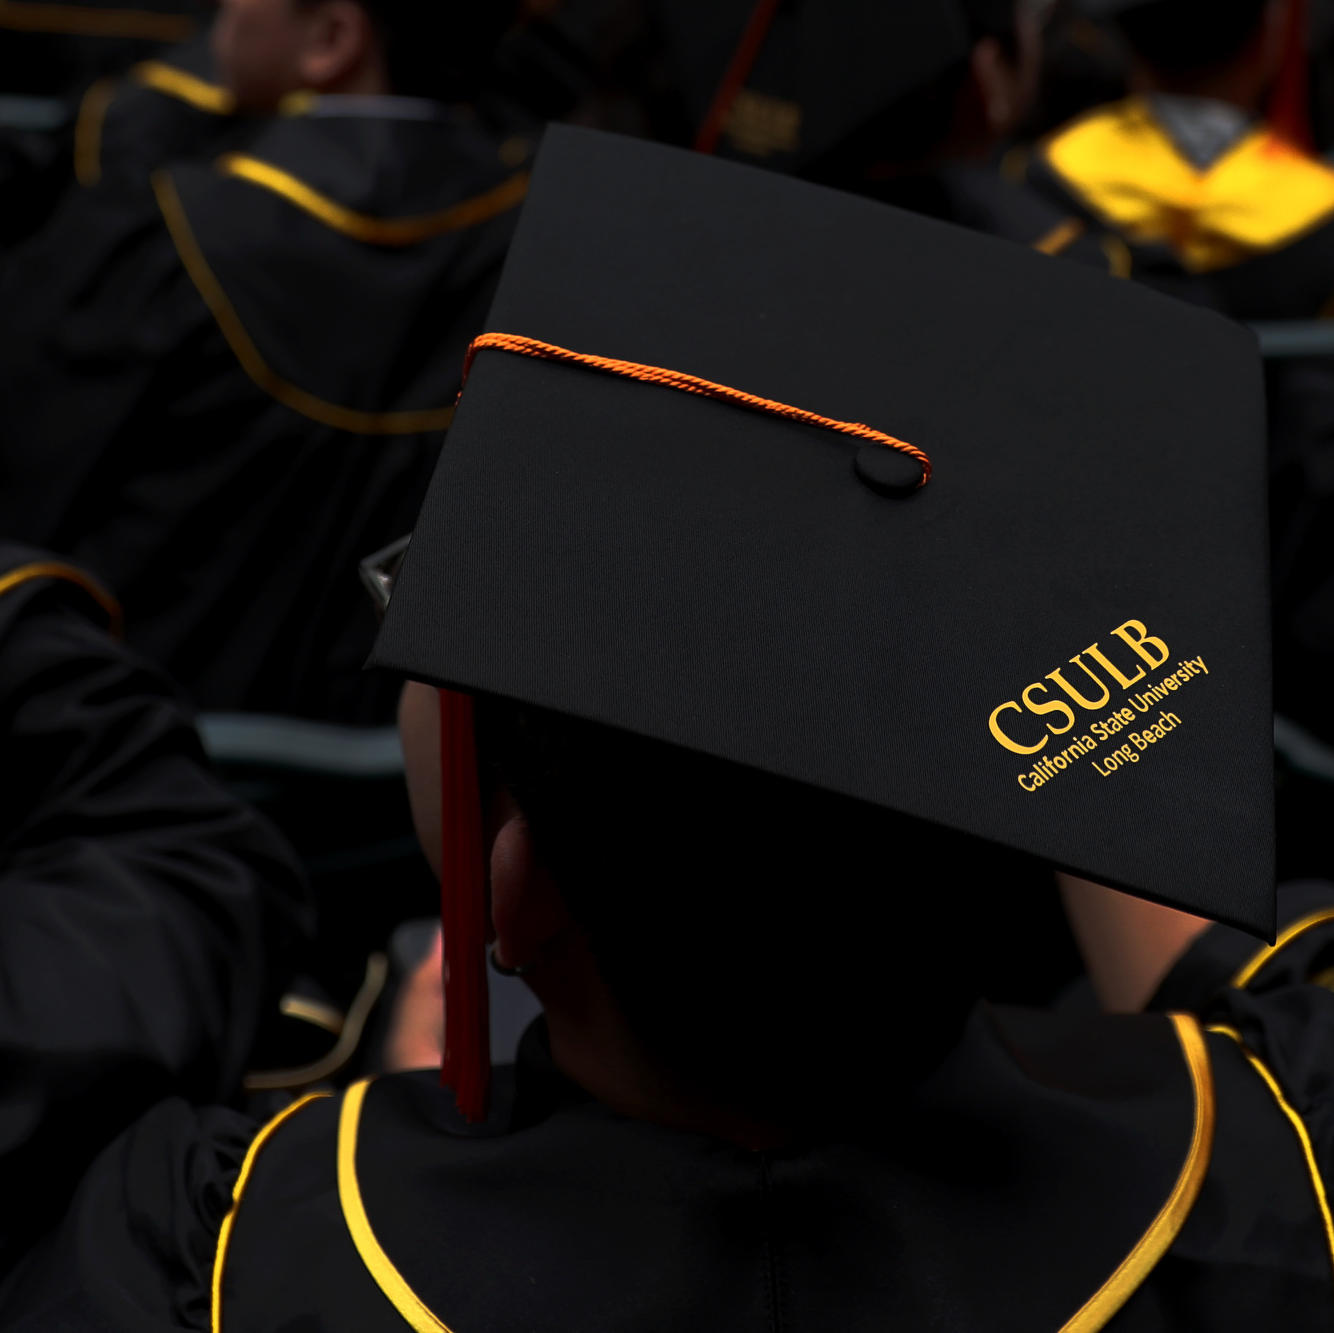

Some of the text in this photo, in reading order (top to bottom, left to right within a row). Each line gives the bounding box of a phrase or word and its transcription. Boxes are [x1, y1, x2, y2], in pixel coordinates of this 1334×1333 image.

[988, 619, 1170, 755] CSULB
[1017, 655, 1209, 792] California State University
[1091, 711, 1182, 777] Long Beach
